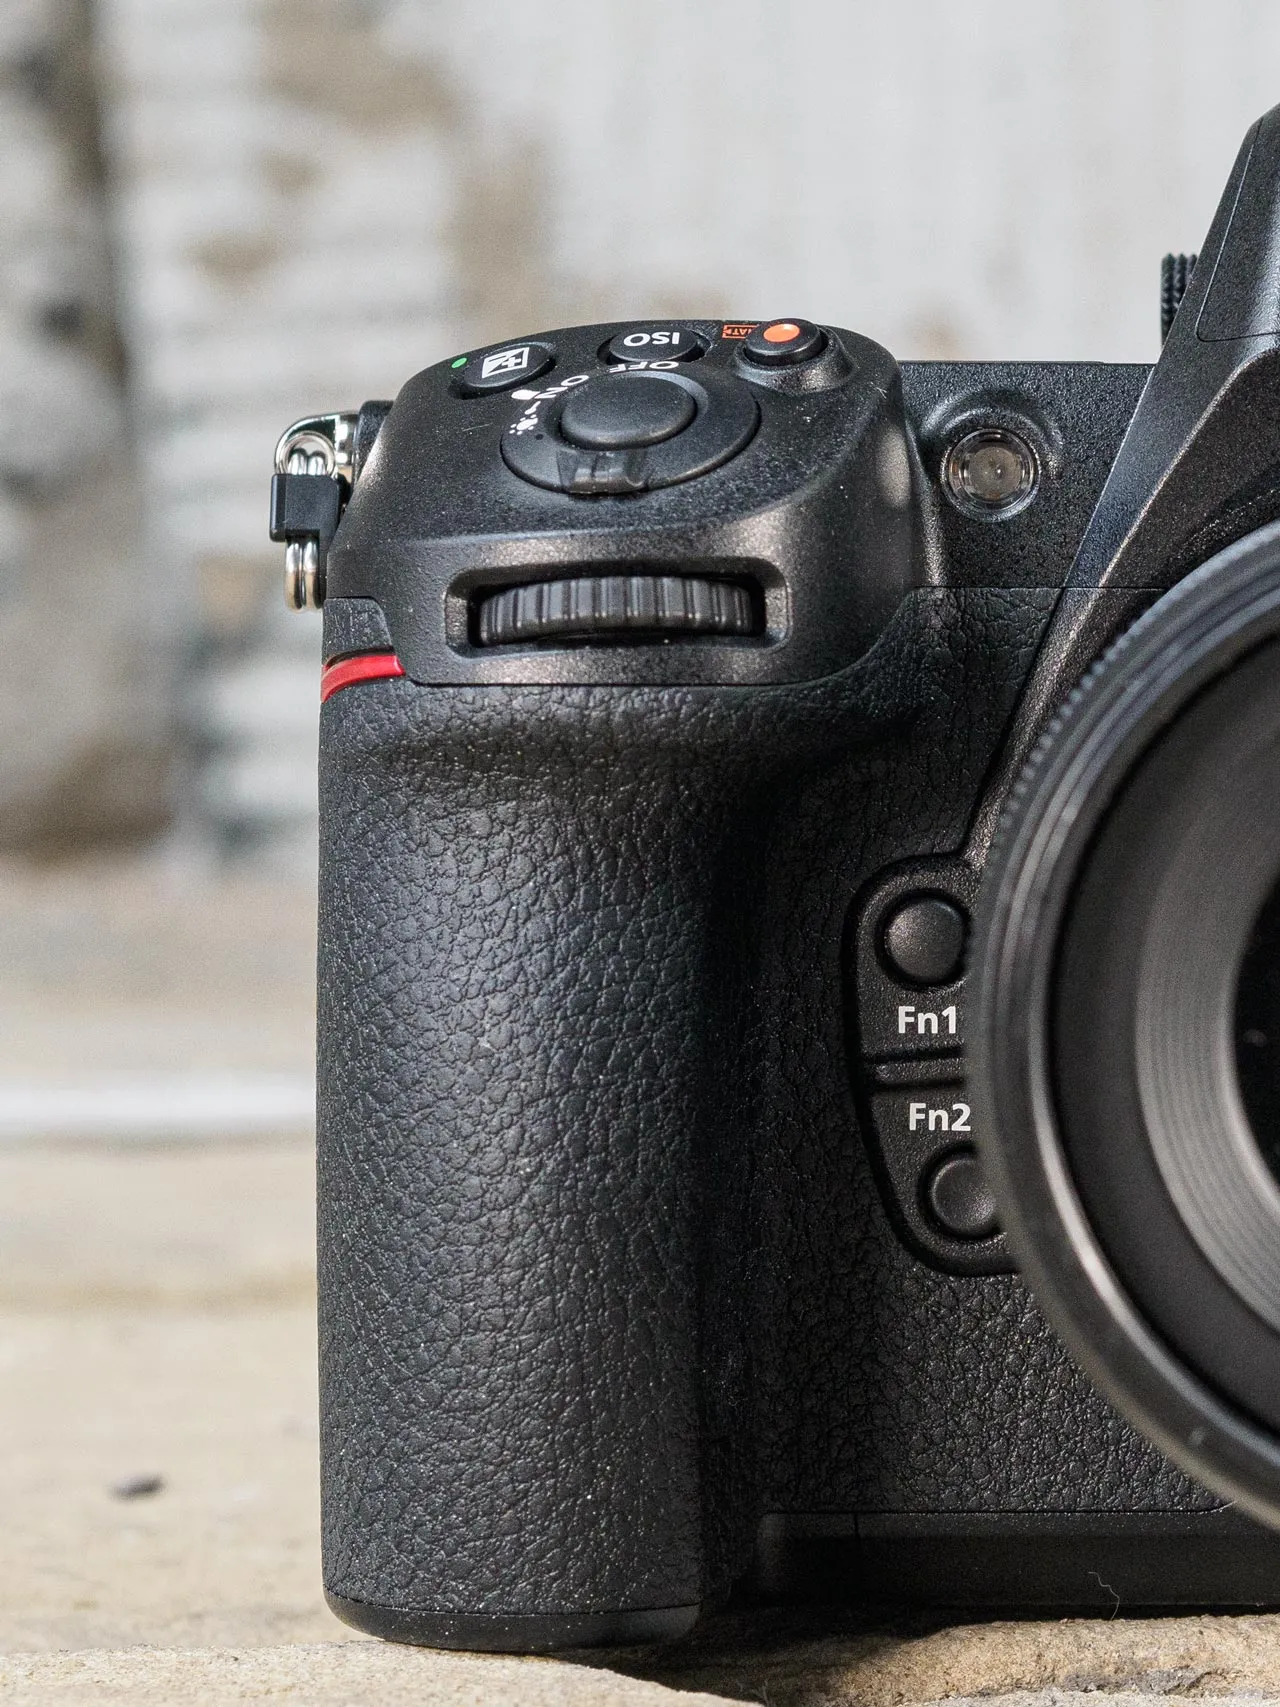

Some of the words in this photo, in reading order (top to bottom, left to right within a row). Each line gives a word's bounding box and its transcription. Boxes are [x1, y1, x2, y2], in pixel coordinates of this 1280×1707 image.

[623, 331, 680, 347] ISO
[609, 361, 679, 373] OFF
[534, 374, 590, 399] ON
[898, 1006, 956, 1034] Fn1
[909, 1103, 971, 1132] Fn2
